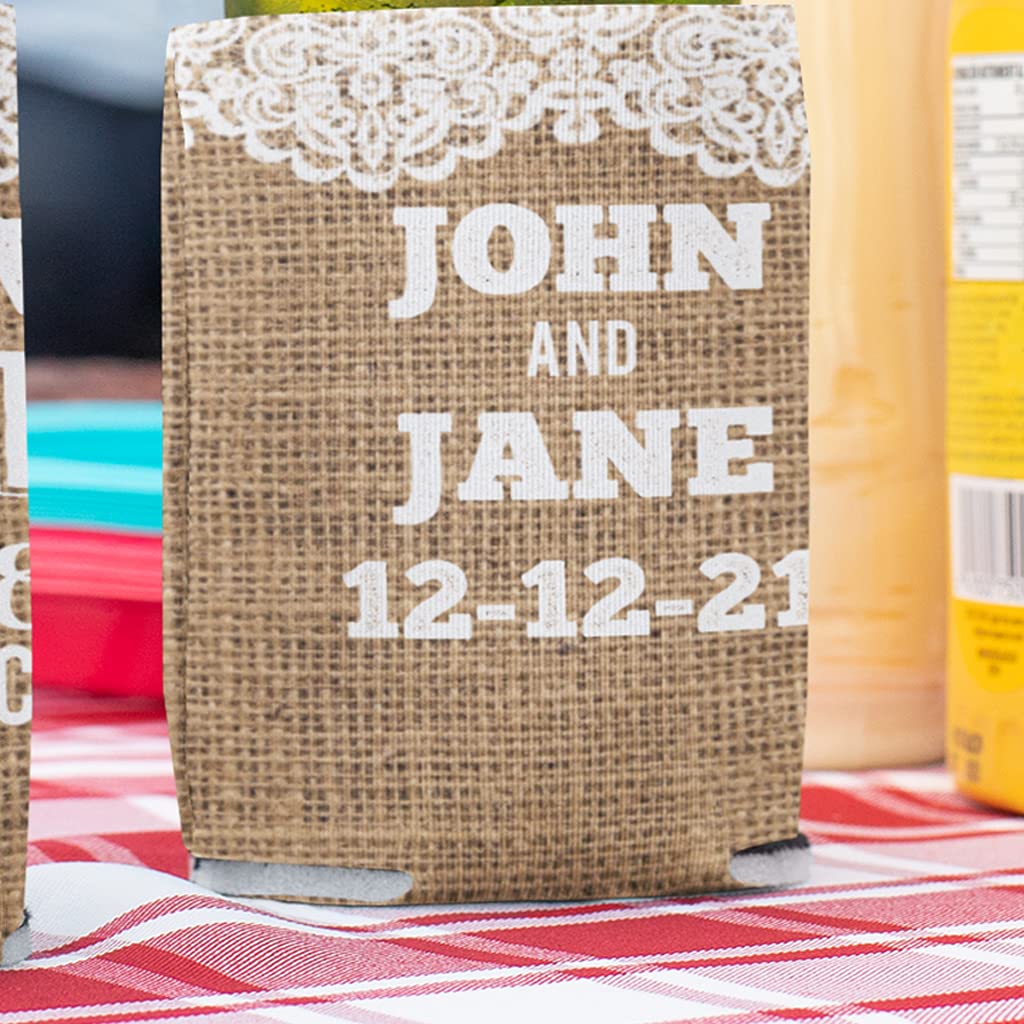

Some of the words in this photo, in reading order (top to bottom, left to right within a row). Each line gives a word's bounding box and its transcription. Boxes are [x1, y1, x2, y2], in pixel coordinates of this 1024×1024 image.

[387, 202, 772, 319] JOHN
[527, 320, 638, 377] AND
[392, 406, 775, 526] JANE
[342, 549, 810, 641] 12-12-21
